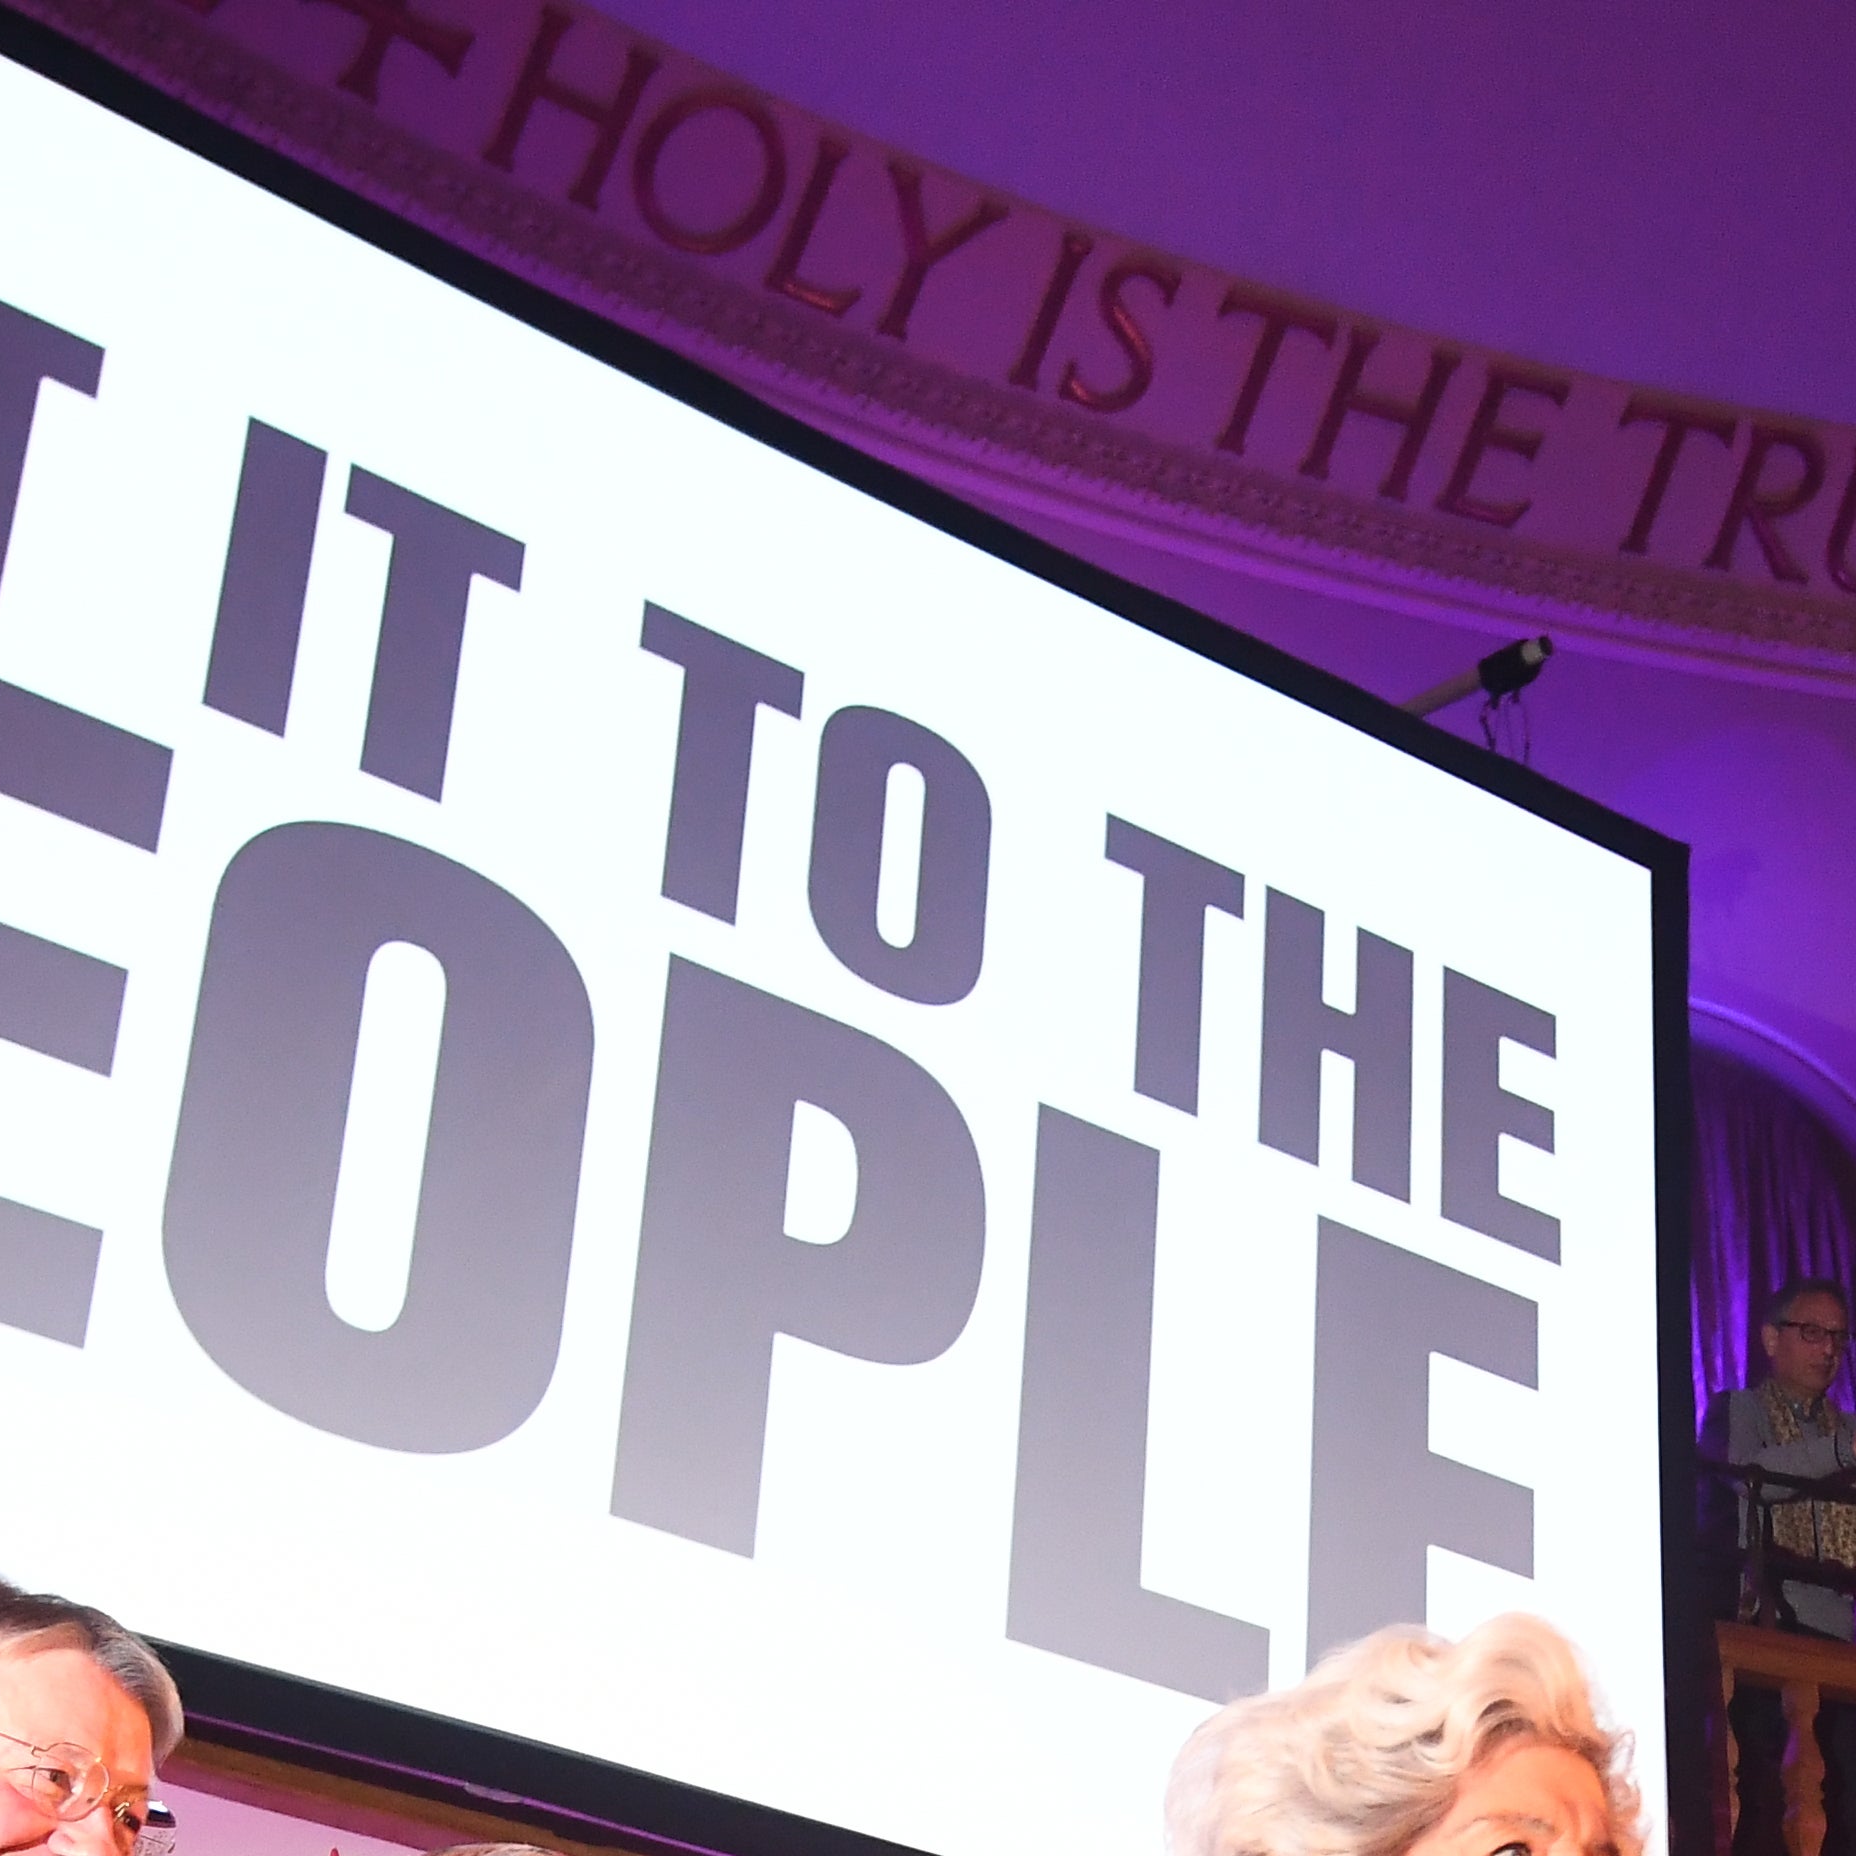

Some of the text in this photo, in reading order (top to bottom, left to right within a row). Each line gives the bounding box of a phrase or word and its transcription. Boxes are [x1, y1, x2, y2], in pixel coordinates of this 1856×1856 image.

[481, 0, 1010, 342] HOLY
[1007, 232, 1181, 415] IS
[1214, 282, 1574, 528] THE
[201, 415, 528, 806] IT
[638, 598, 993, 1008] TO
[1104, 811, 1562, 1267] THE
